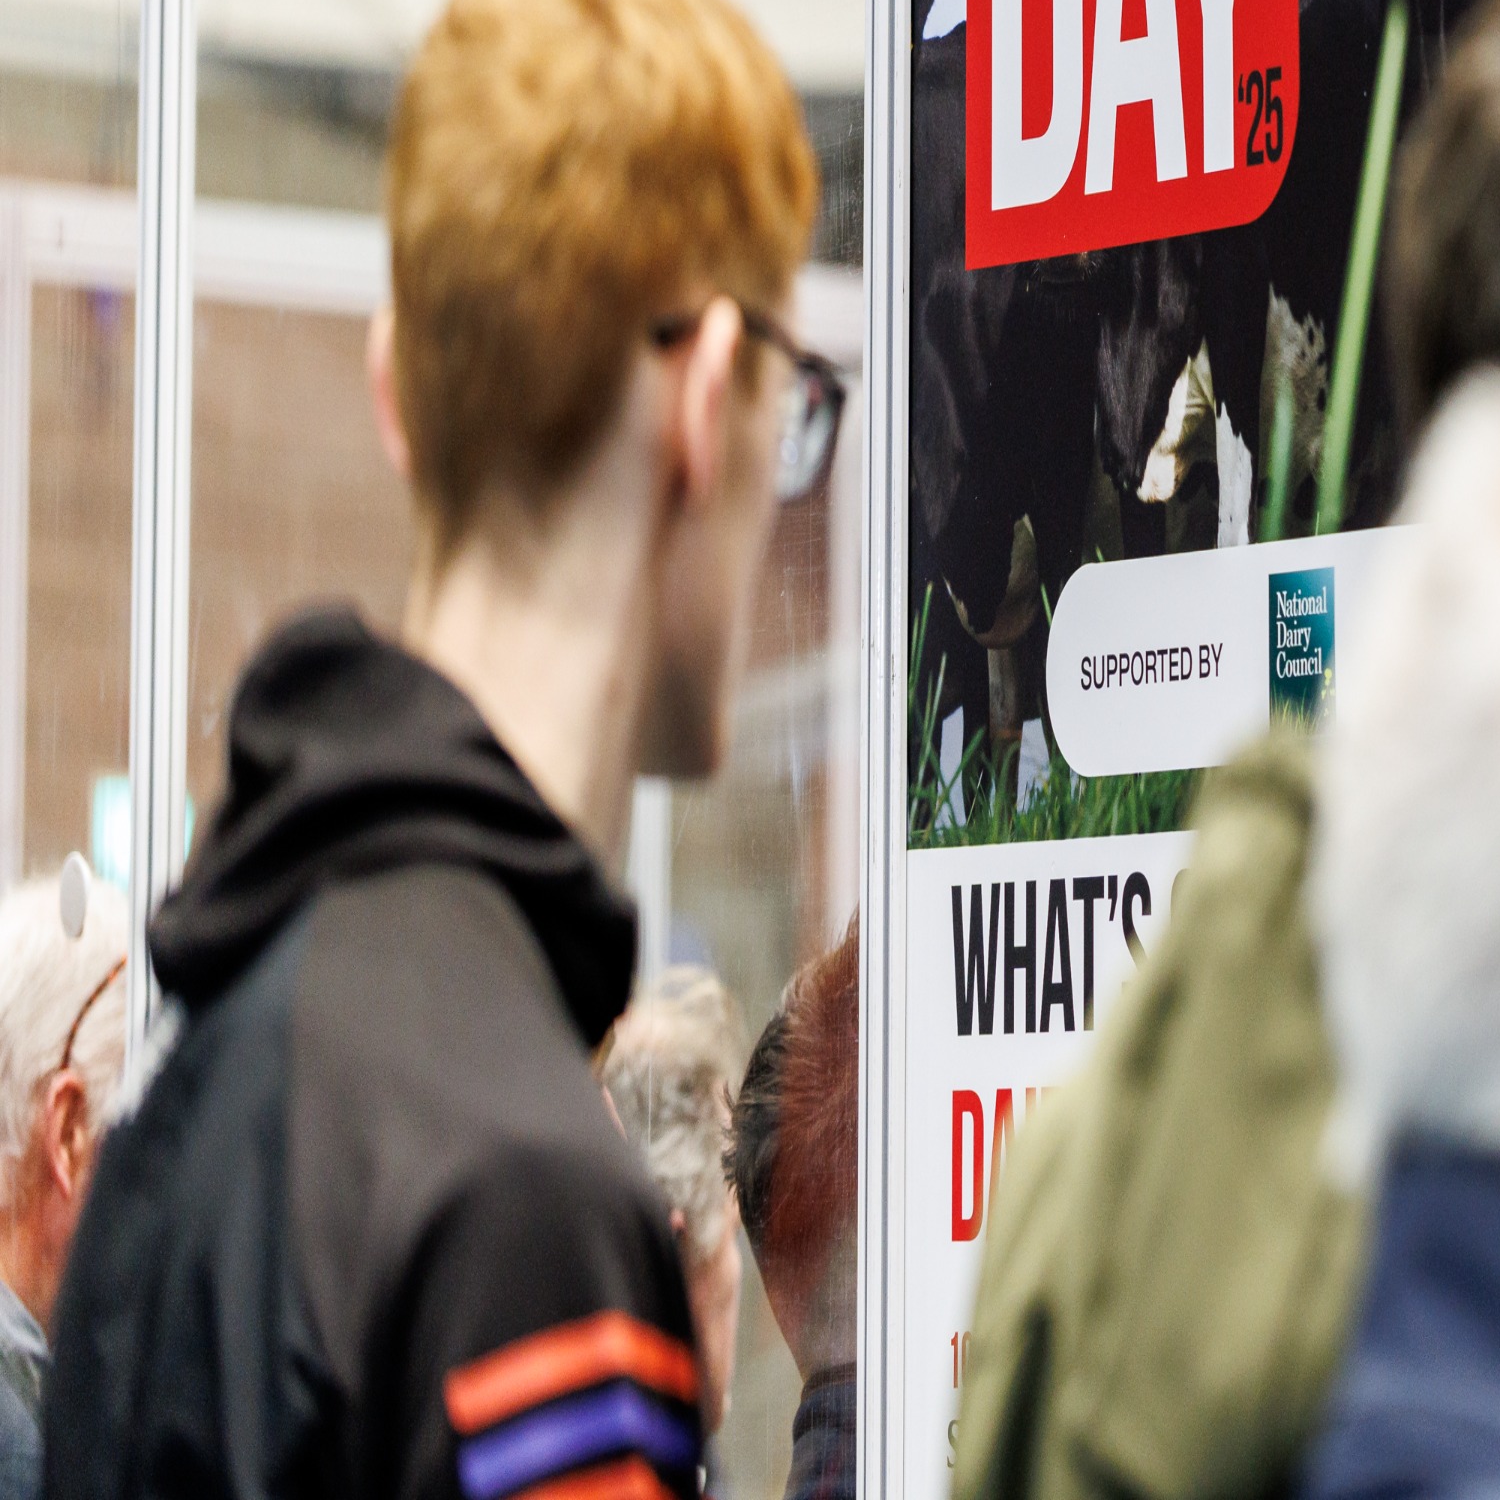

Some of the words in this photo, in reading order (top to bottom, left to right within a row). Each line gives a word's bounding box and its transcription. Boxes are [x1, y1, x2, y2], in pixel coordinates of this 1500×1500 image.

[1238, 65, 1284, 167] '25
[1276, 586, 1328, 619] National
[1276, 620, 1312, 652] Dairy
[1080, 646, 1193, 691] SUPPORTED
[1198, 642, 1224, 679] BY
[1276, 647, 1323, 679] Council
[951, 871, 1152, 1036] WHAT'S
